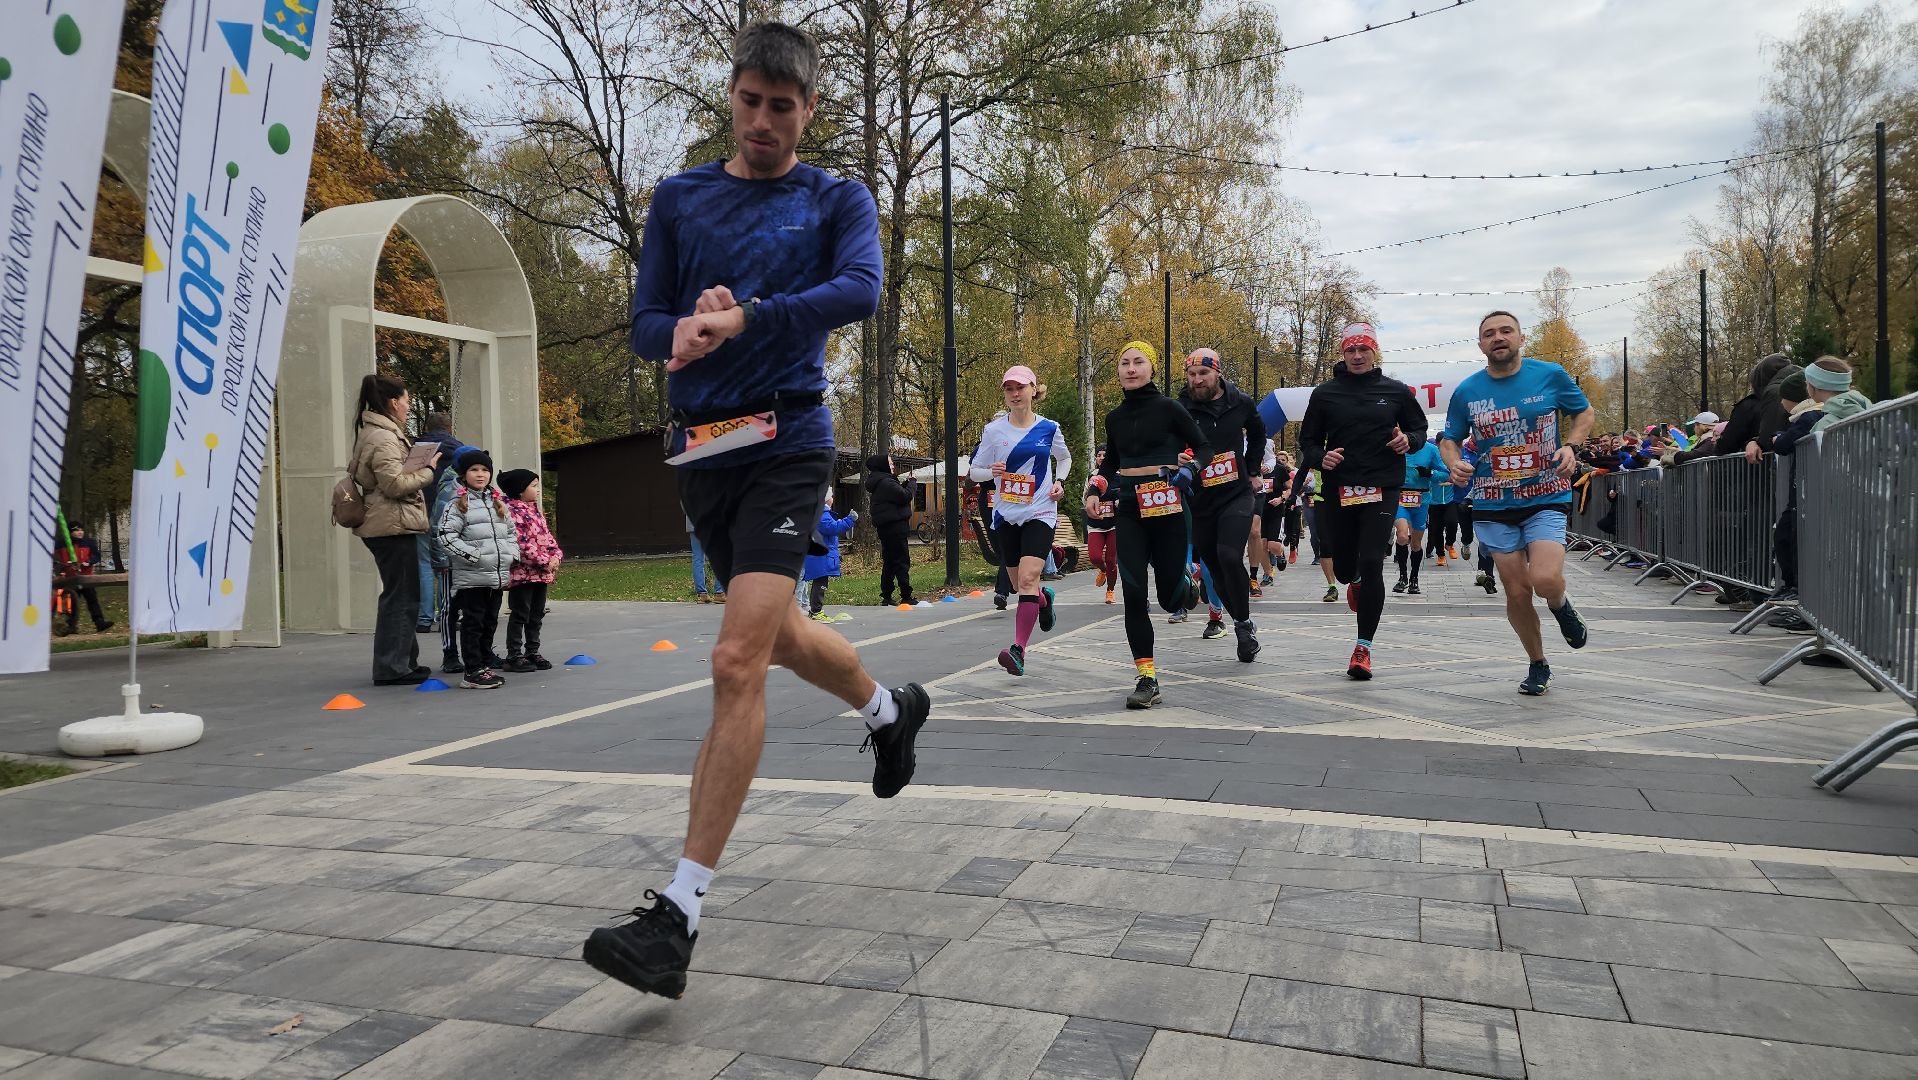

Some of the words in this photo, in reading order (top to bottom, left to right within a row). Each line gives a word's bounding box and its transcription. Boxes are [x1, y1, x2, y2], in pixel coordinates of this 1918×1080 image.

[17, 92, 48, 192] СТУПИНО
[8, 184, 36, 258] ОКРУГ
[241, 186, 267, 263] СТУПИНО
[175, 192, 231, 396] СПОРТ
[233, 257, 257, 314] ОКРУГ
[221, 311, 248, 416] ГОРОДСКОЙ
[1467, 397, 1496, 416] 2024
[1473, 406, 1520, 427] #МЕЧТА
[1203, 460, 1233, 478] 301
[1497, 453, 1534, 470] 353
[1004, 480, 1031, 495] 343
[1141, 489, 1178, 507] 308
